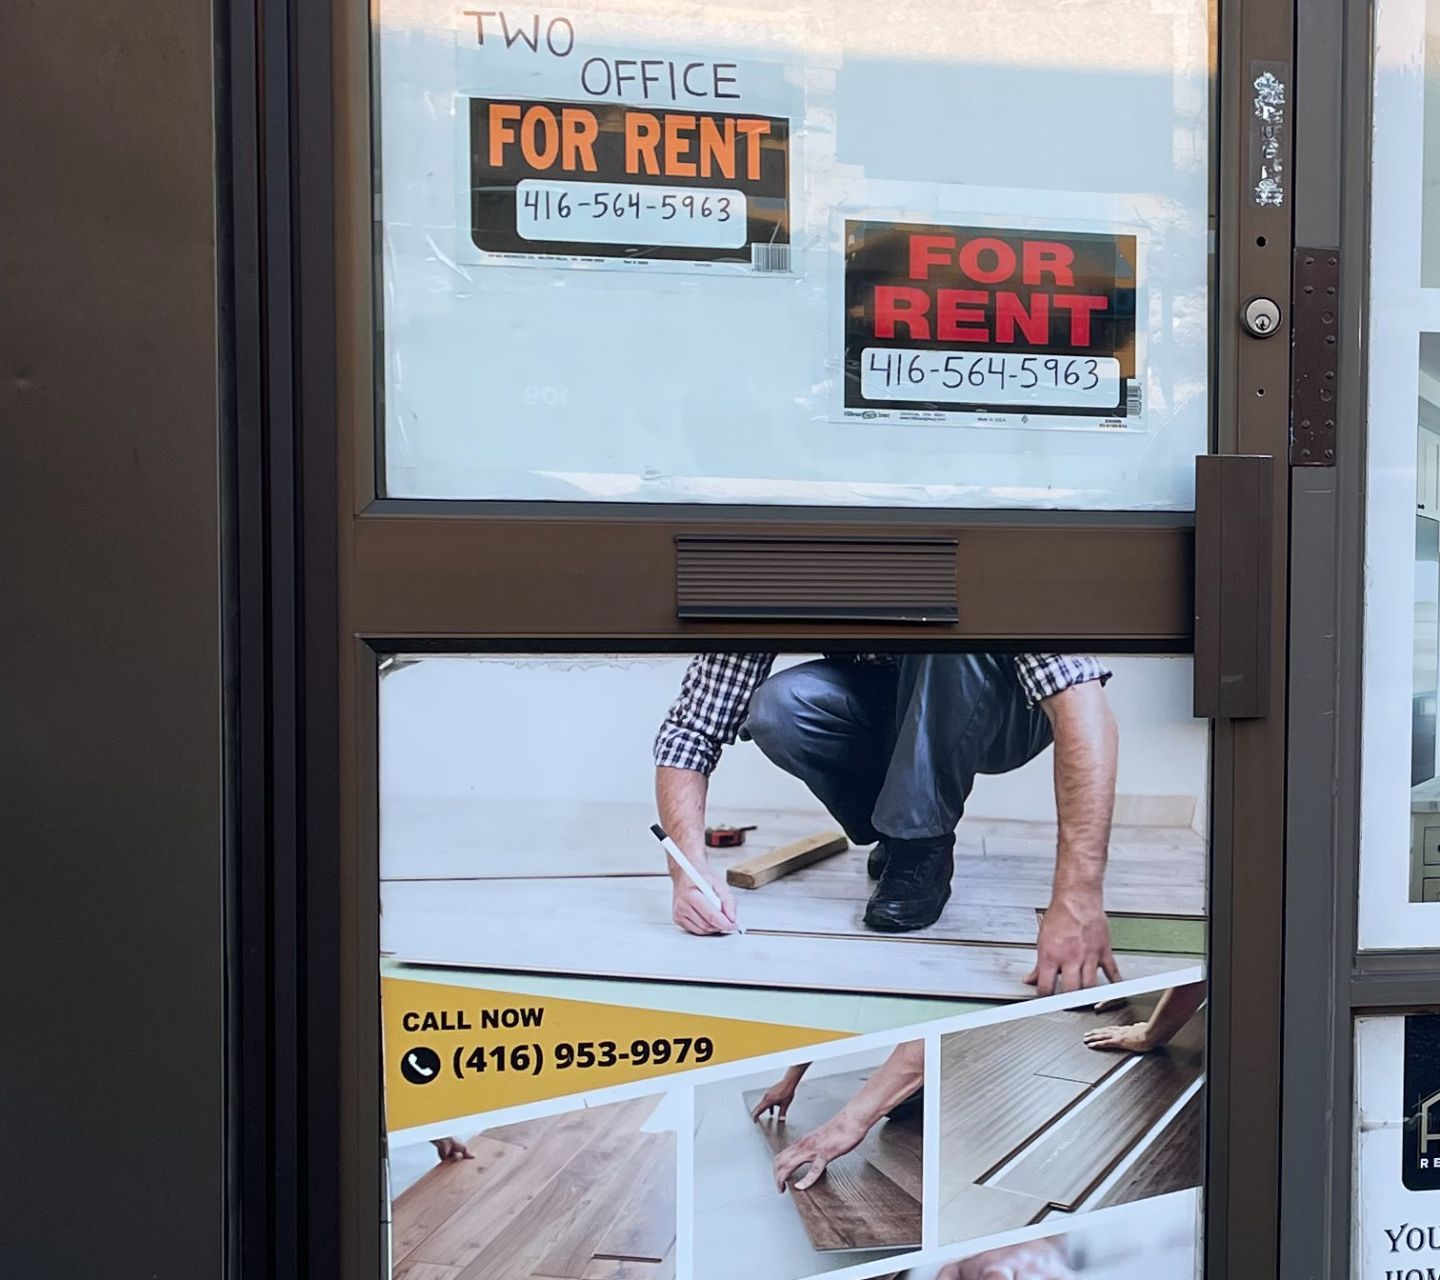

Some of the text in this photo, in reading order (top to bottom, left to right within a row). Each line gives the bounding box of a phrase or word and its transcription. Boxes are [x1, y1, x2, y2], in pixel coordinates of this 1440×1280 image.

[463, 10, 574, 57] TWO
[582, 57, 741, 100] OFFICE
[489, 103, 771, 180] FOR RENT
[524, 191, 731, 221] 416-564-5963
[908, 234, 1075, 287] FOR
[874, 285, 1108, 347] RENT
[870, 353, 1099, 390] 416-564-5963
[403, 1008, 544, 1032] CALL NOW
[453, 1037, 714, 1079] (416) 953-9979
